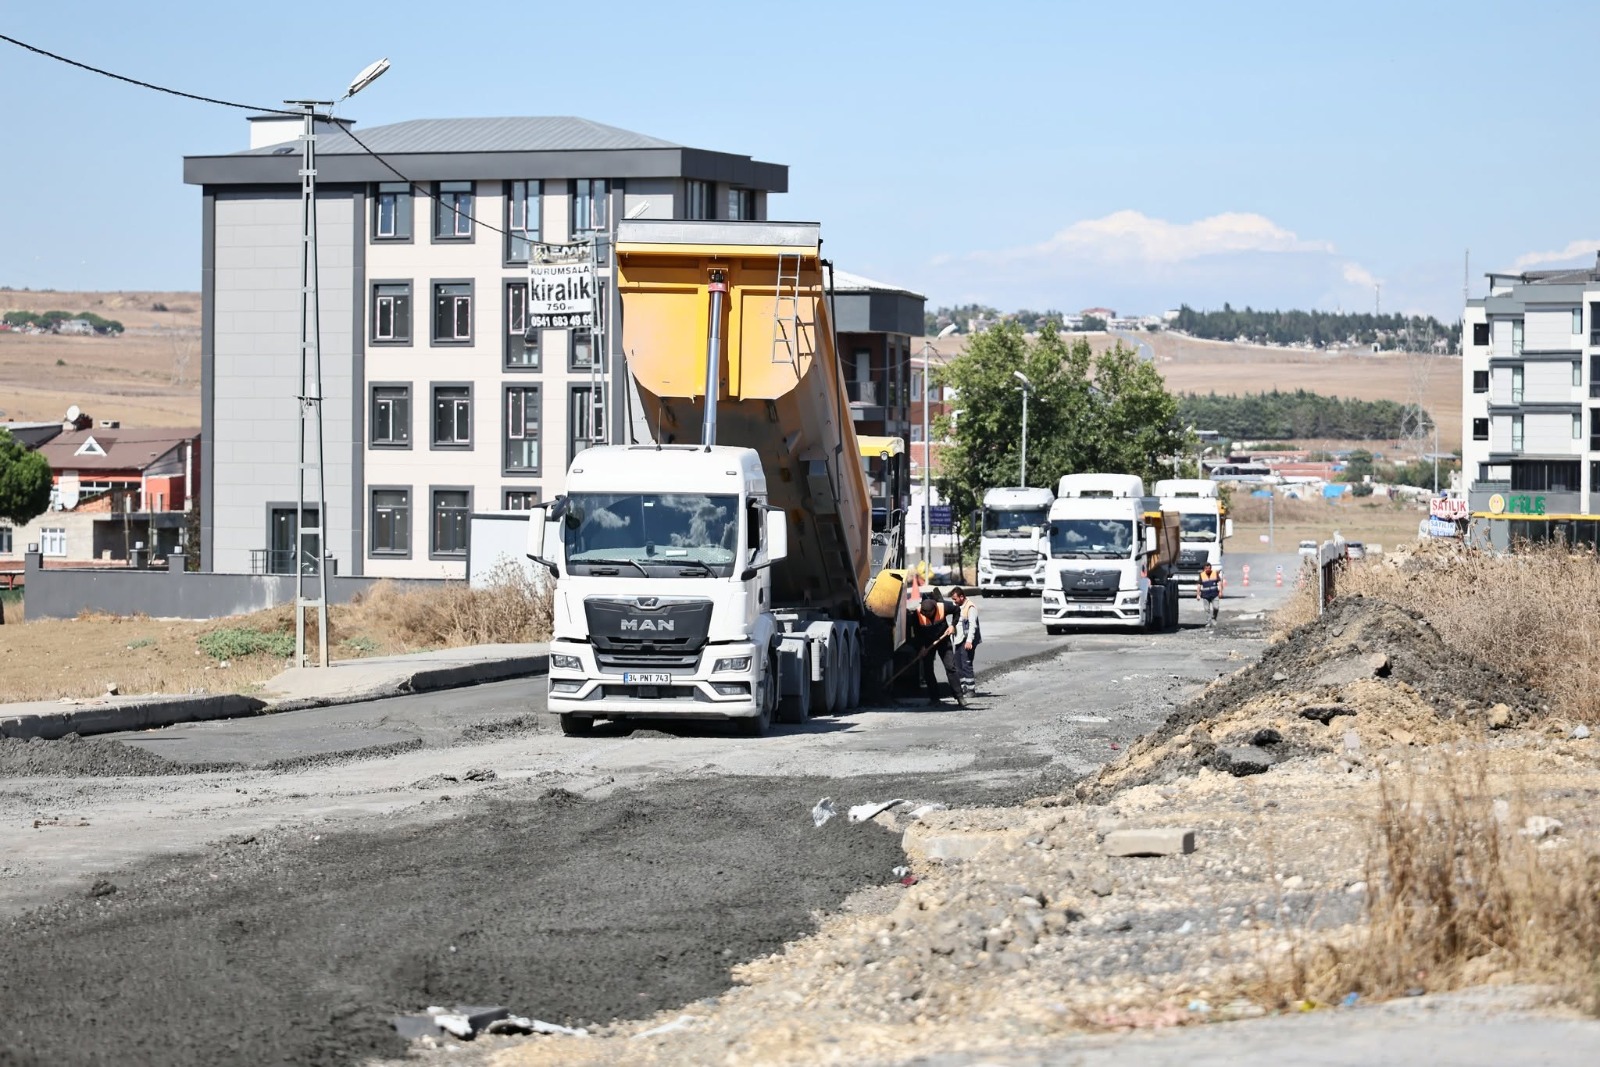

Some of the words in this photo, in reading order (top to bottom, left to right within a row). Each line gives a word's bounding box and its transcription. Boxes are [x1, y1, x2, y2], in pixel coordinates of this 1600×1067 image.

[531, 265, 590, 275] KURUMSALA
[531, 276, 591, 301] kiralık
[531, 316, 550, 327] 0541
[552, 316, 568, 326] 683
[569, 315, 581, 325] 49
[1432, 500, 1466, 511] SATILIK
[621, 619, 675, 631] MAN
[628, 674, 637, 682] 34
[640, 674, 653, 682] PNT
[655, 674, 669, 682] 743
